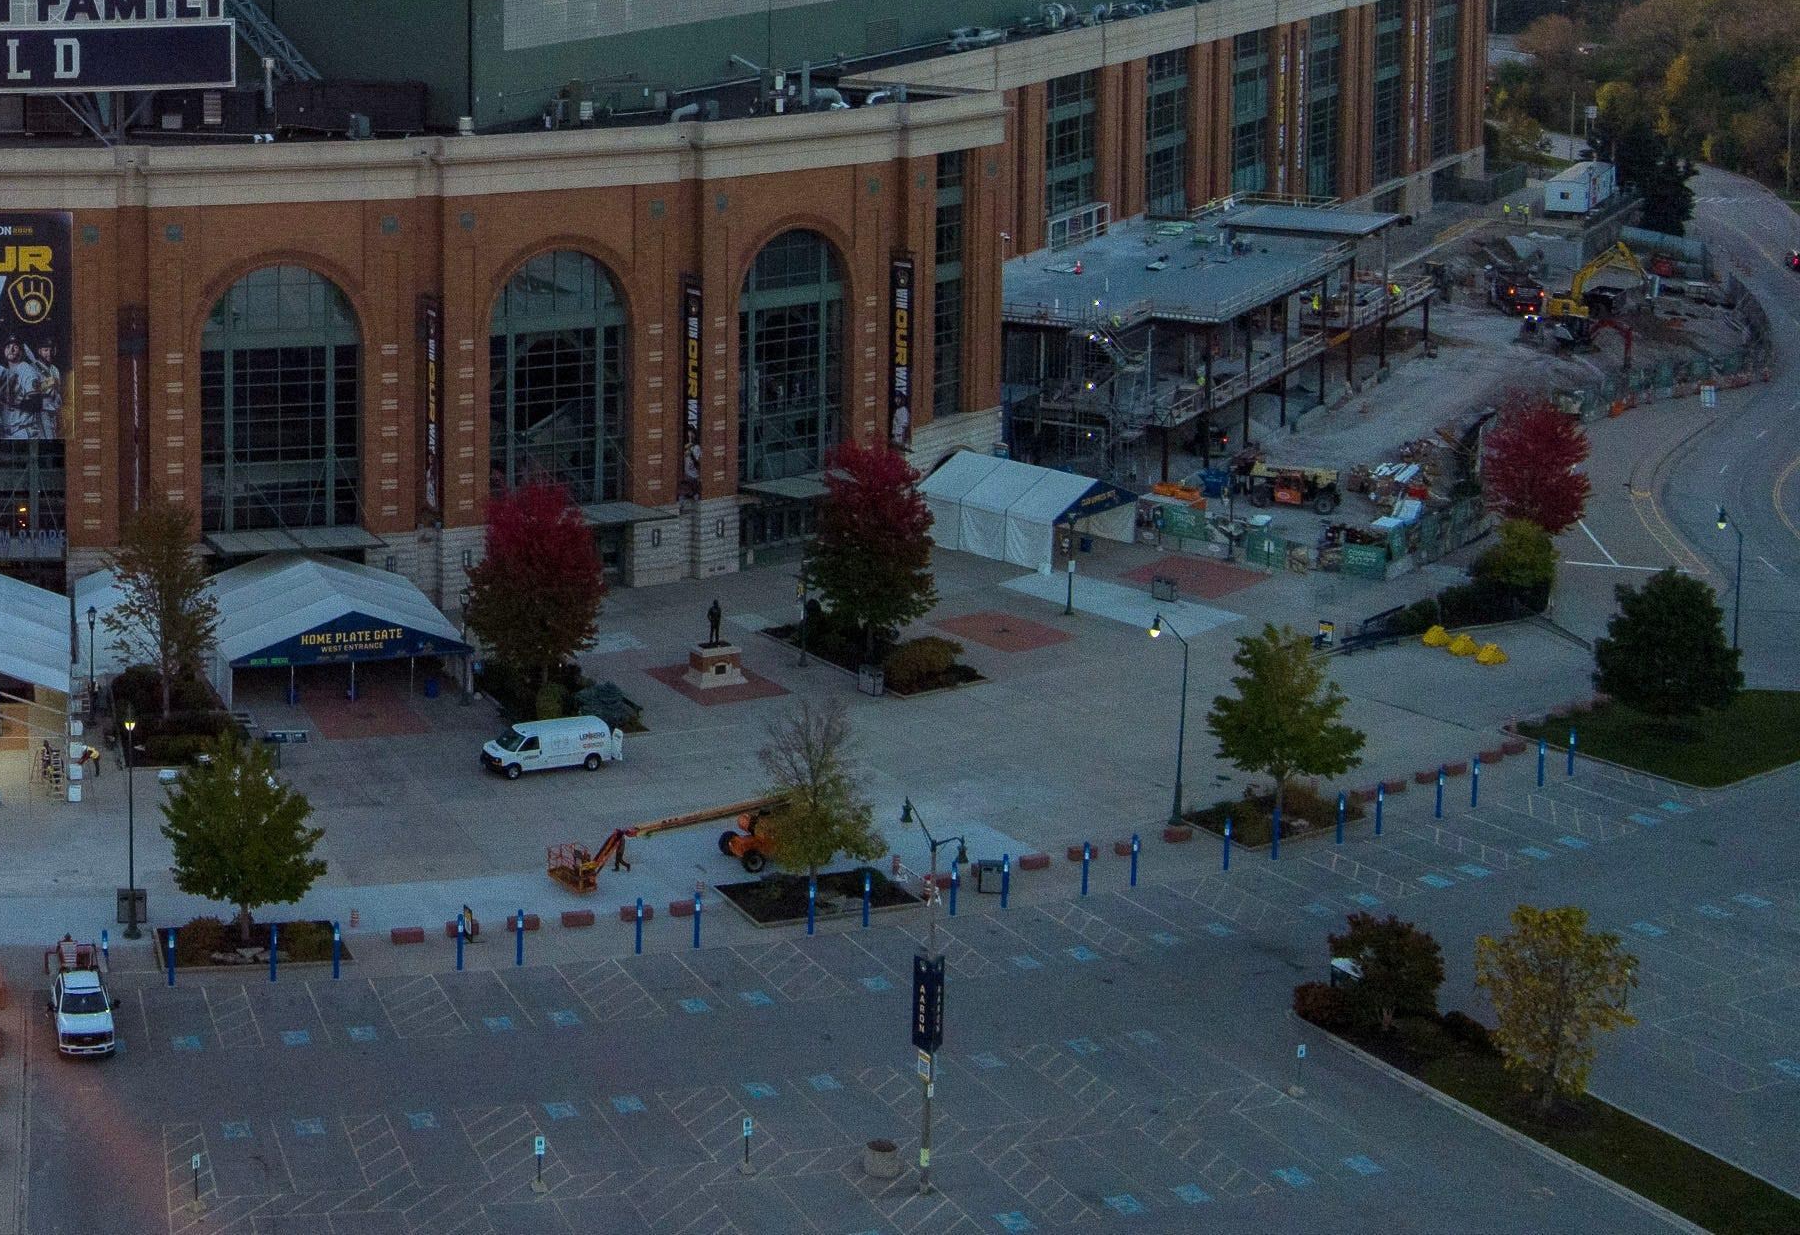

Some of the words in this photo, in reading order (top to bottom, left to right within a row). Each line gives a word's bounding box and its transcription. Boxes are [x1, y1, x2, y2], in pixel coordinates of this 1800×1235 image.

[895, 288, 909, 310] WIN
[687, 316, 699, 340] WIN
[895, 308, 909, 366] OUR
[687, 338, 699, 399] OUR
[894, 366, 908, 396] WAY
[687, 398, 699, 430] WAY
[300, 633, 332, 646] HOME
[335, 630, 371, 644] PLATE
[373, 627, 404, 640] GATE
[320, 645, 342, 653] WEST
[343, 642, 384, 651] ENTRANCE
[918, 984, 926, 1034] AARON
